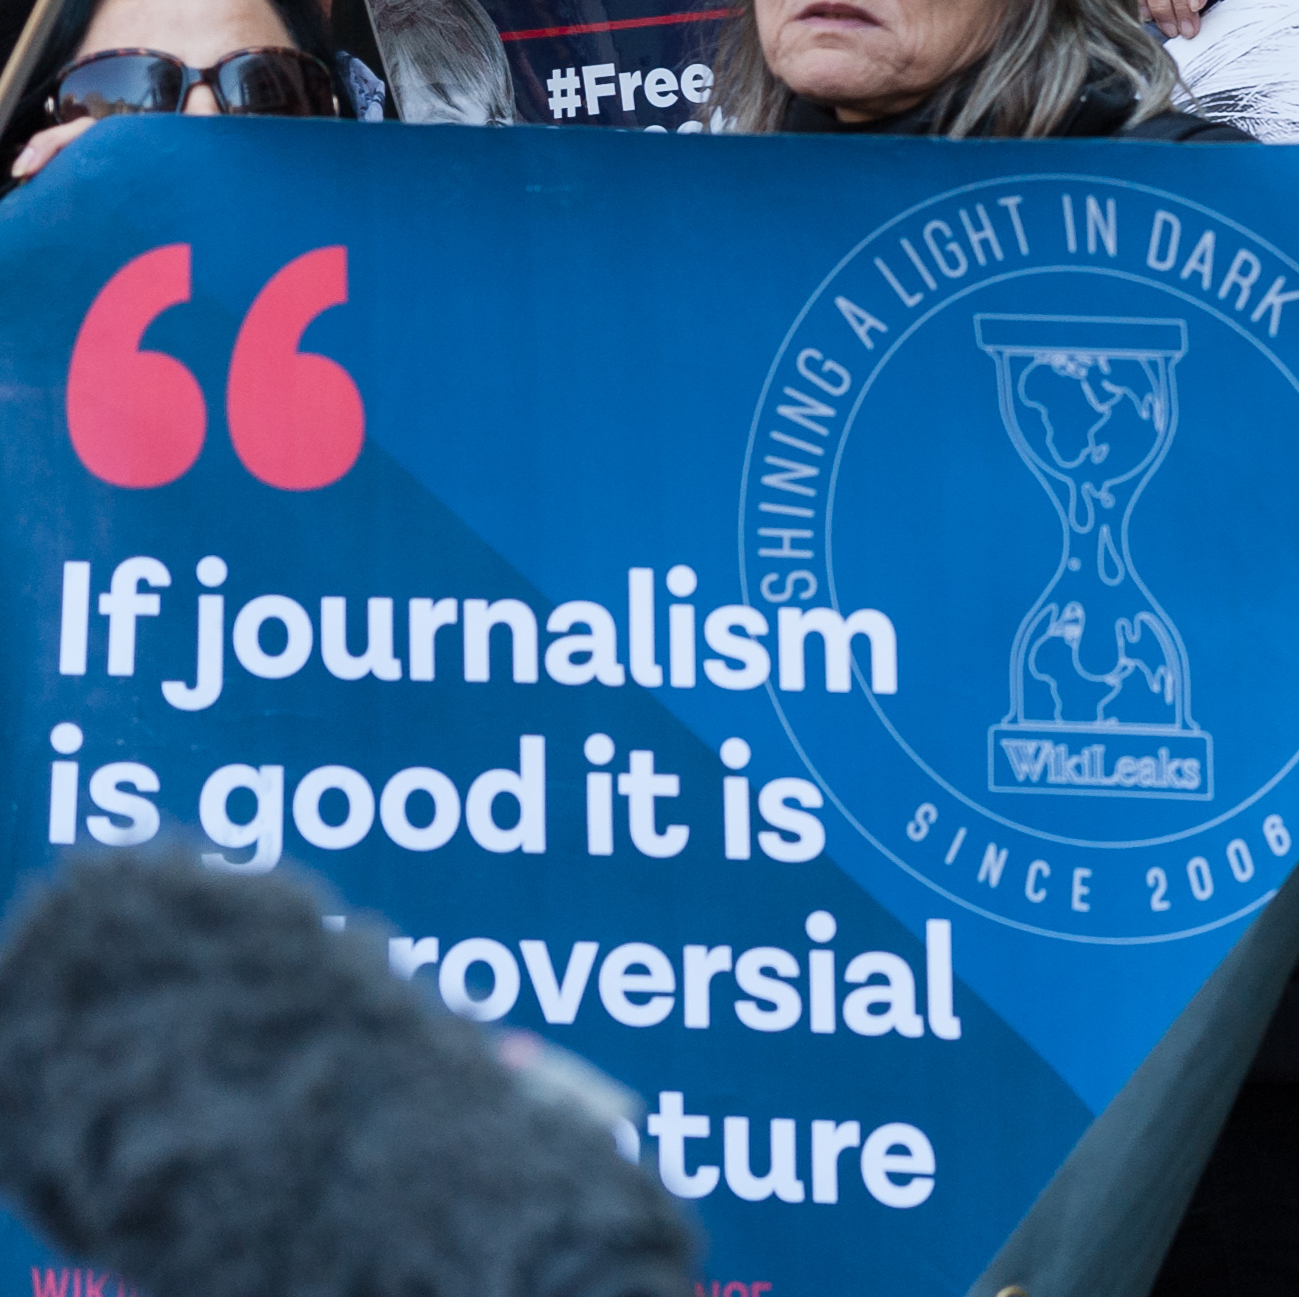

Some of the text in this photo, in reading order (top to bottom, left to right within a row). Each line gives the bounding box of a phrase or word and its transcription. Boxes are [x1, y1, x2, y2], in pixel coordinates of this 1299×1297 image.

[546, 62, 715, 119] #Free
[757, 347, 852, 604] SHINING
[834, 296, 889, 351] A
[873, 194, 1030, 309] LIGHT
[1062, 194, 1118, 258] IN
[59, 555, 898, 710] If journalism
[48, 723, 826, 874] is good it is
[905, 801, 1293, 912] SINCE 2006
